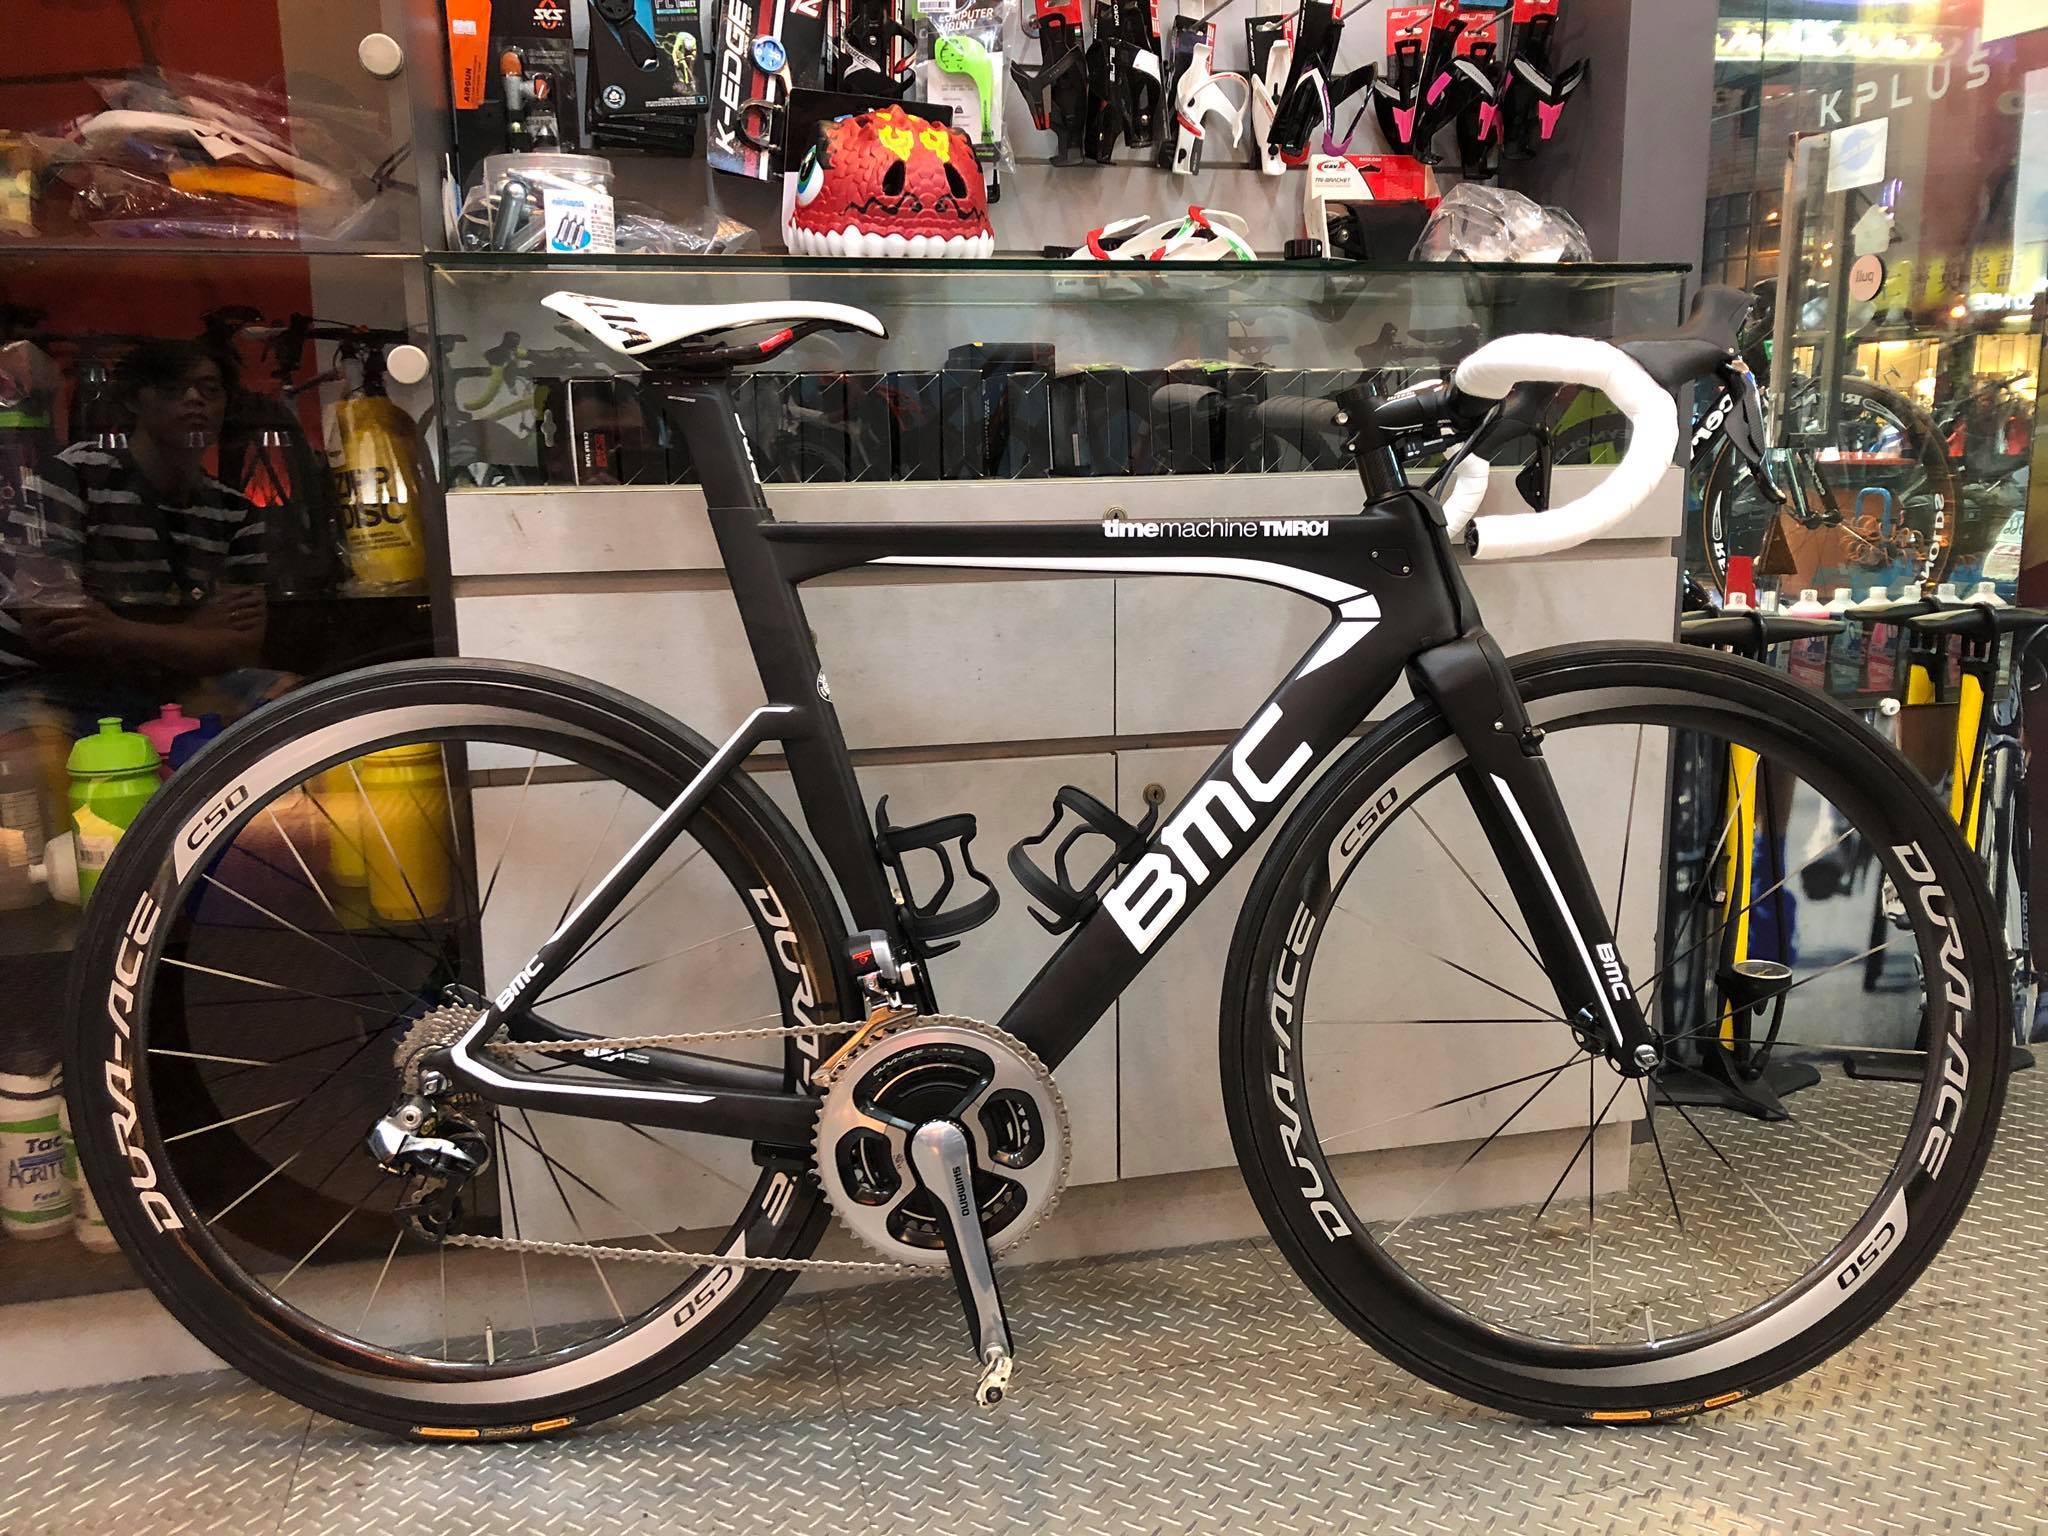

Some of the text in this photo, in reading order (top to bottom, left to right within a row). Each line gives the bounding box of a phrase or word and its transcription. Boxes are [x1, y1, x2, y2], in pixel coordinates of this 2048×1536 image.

[533, 8, 566, 20] SKS
[715, 0, 748, 154] K-EDGE
[1819, 48, 1990, 127] KPLUS
[1260, 520, 1329, 537] TMR01
[187, 784, 249, 851] C50
[1102, 701, 1314, 954] BMC
[1340, 786, 1399, 857] C50
[495, 954, 545, 1012] BMC
[1595, 942, 1632, 1001] BMC
[1892, 840, 1972, 1180] DURA-ACE
[105, 890, 184, 1234] DURA-ACE
[1270, 900, 1352, 1243] DURA-ACE
[952, 1165, 970, 1217] SHIMANO
[1836, 1221, 1896, 1291] C50
[672, 1266, 733, 1328] C50
